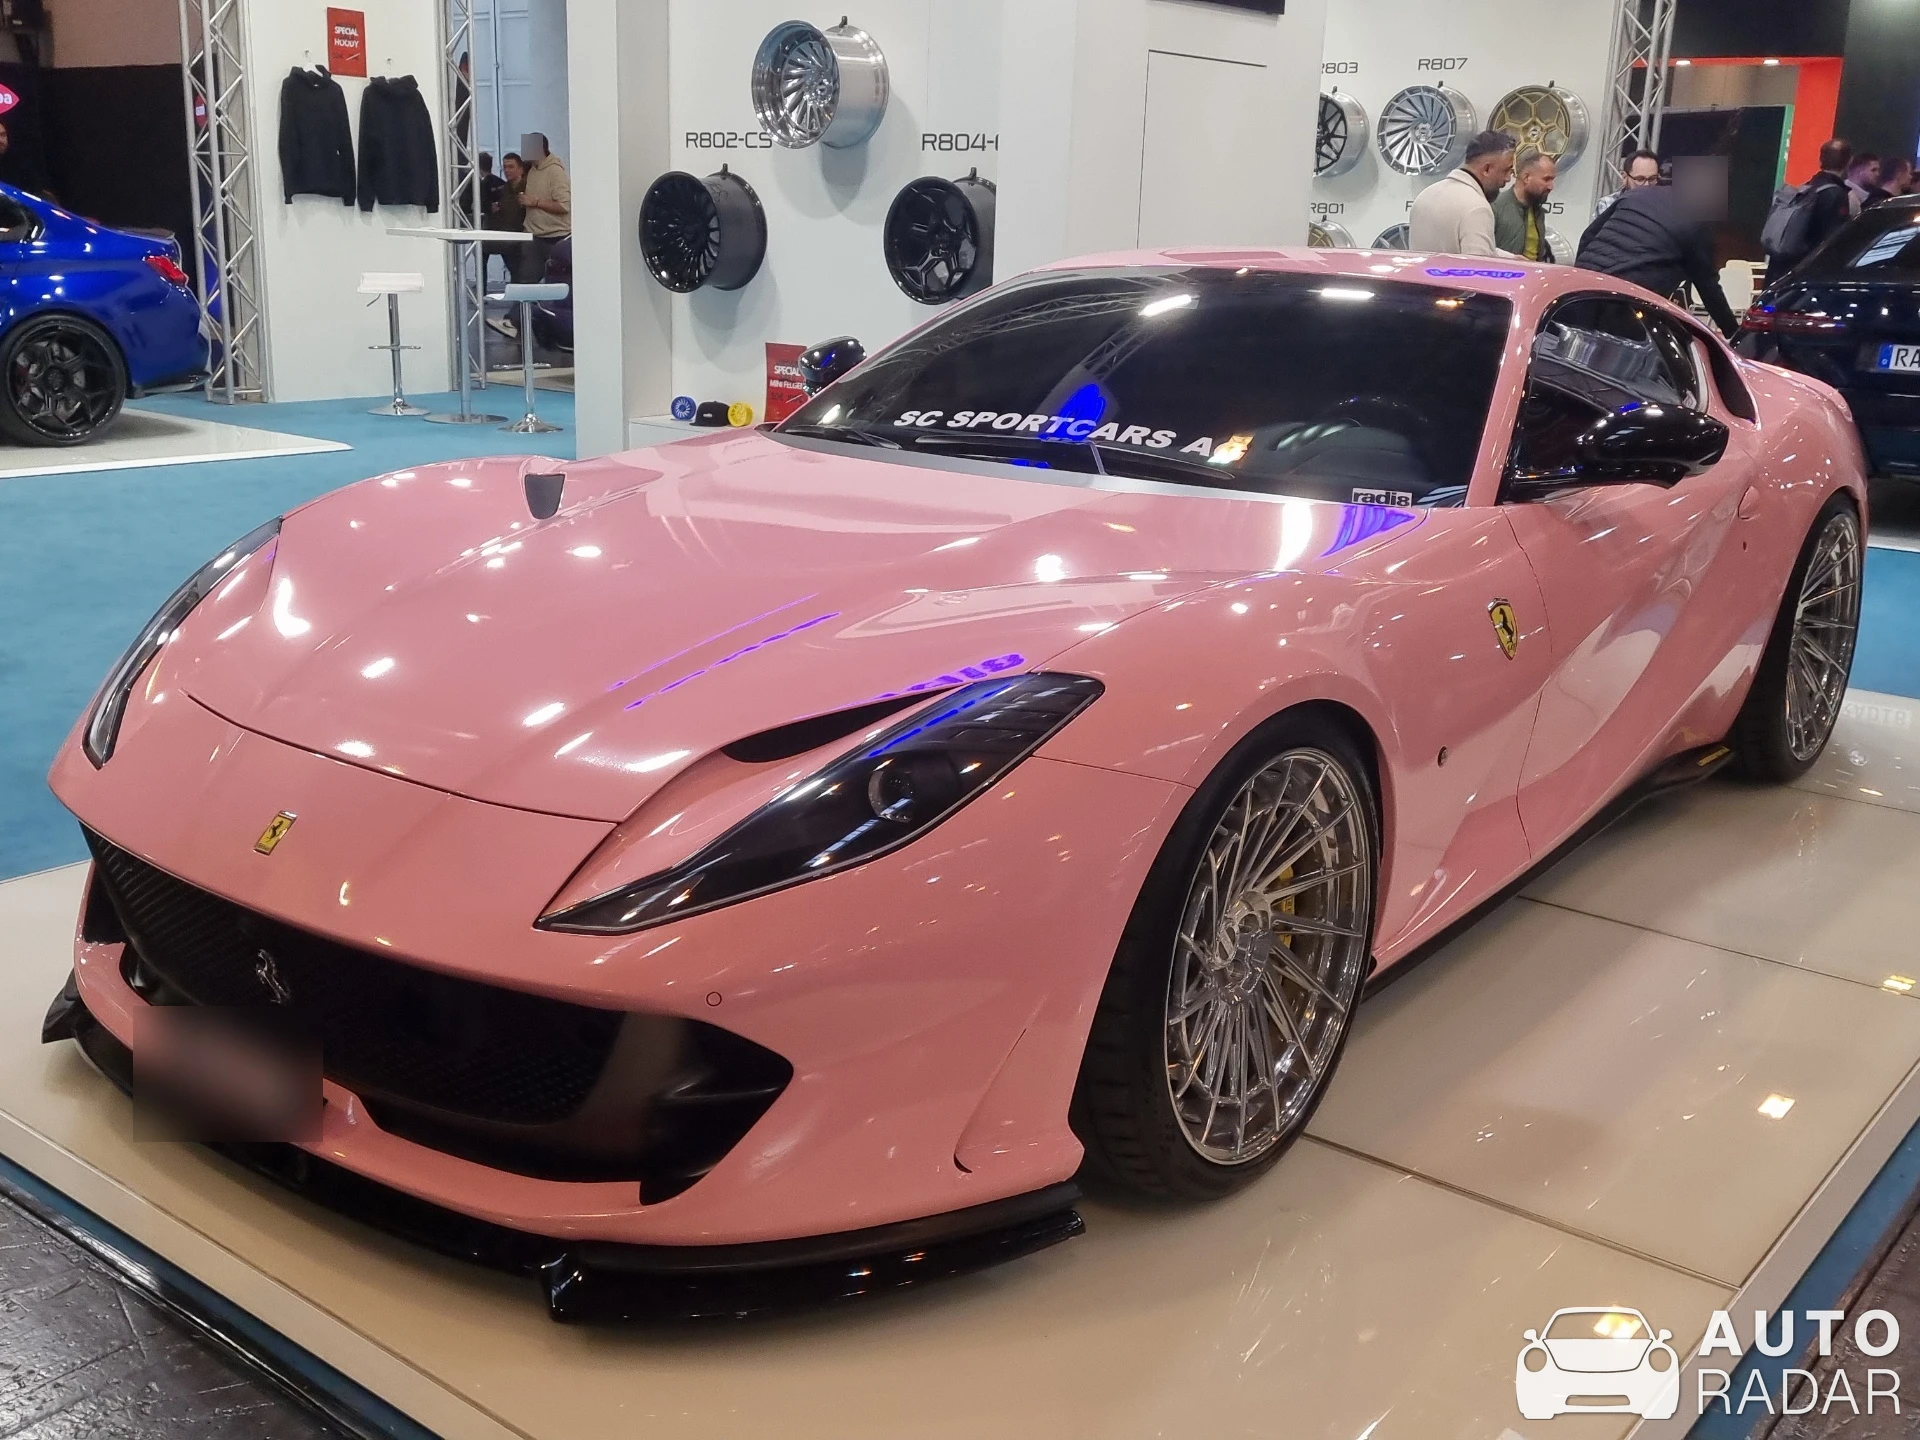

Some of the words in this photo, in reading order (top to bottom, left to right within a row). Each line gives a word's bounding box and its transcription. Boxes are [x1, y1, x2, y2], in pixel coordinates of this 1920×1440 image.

[334, 26, 359, 36] SPECIAL
[1418, 57, 1468, 71] R807
[685, 132, 773, 149] R802-CS
[774, 365, 801, 376] SPECIAL
[893, 410, 944, 427] SC
[946, 411, 1177, 449] SPORTCARS
[1353, 491, 1410, 507] radi8
